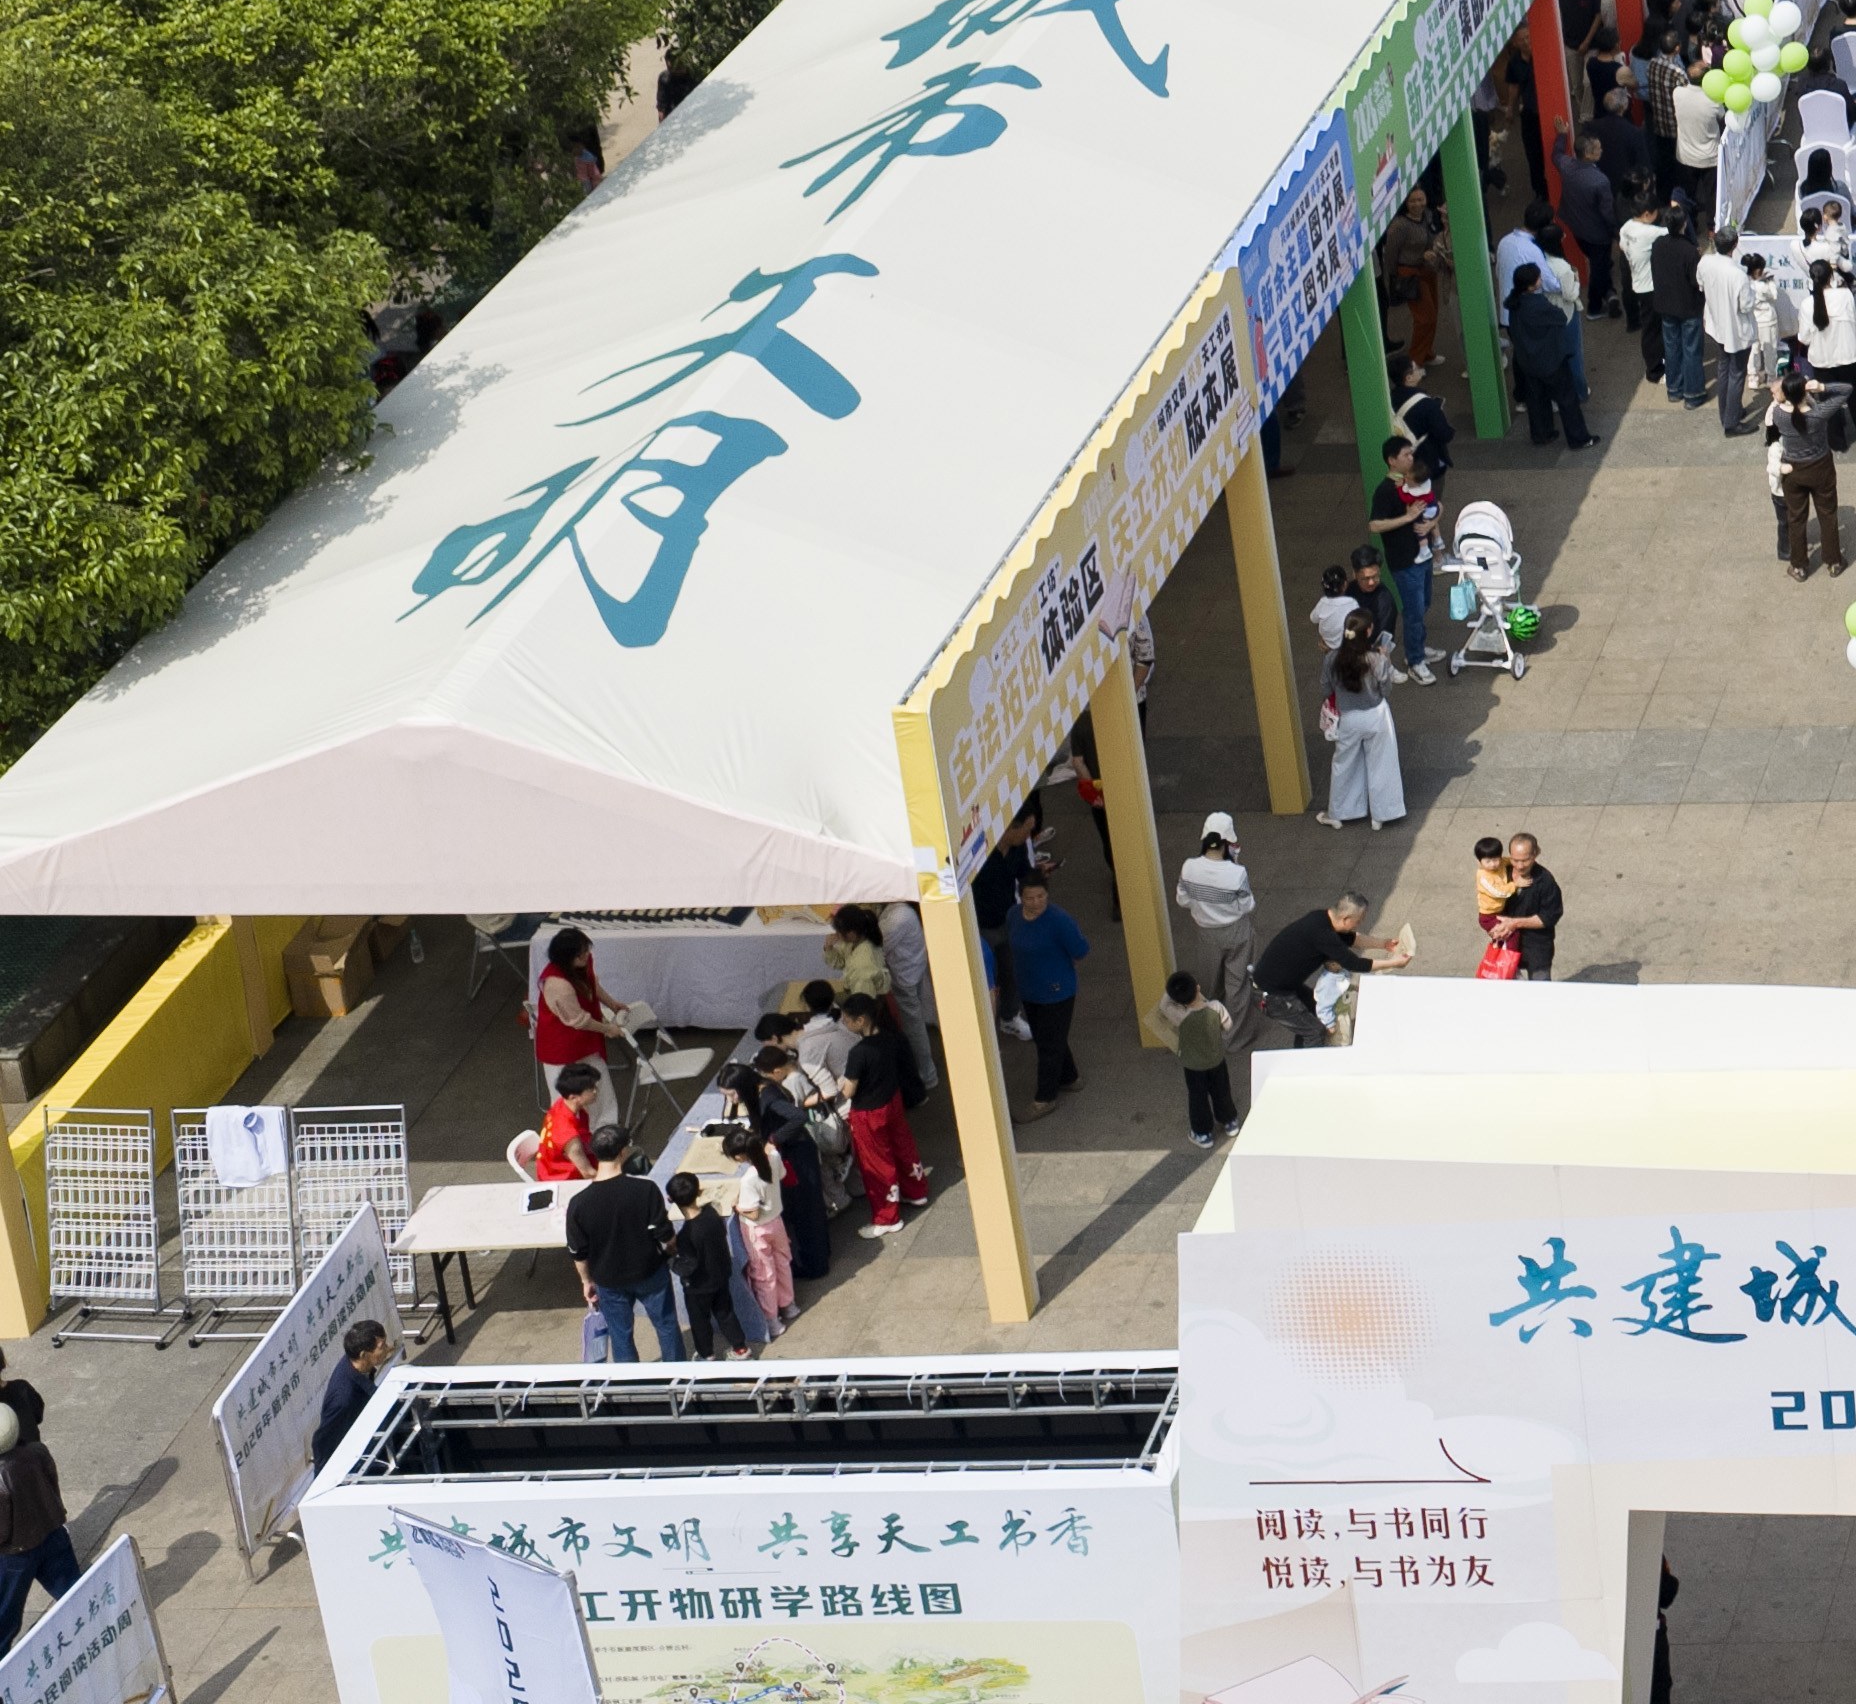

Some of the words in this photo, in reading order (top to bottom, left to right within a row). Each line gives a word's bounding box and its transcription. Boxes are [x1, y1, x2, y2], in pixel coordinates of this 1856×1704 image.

[1259, 170, 1347, 323] 新余主题图书展
[1110, 340, 1240, 567] 天工开物版本展
[951, 542, 1105, 804] 古法拓印体验区
[757, 1508, 1095, 1559] 共享天工书香
[25, 1582, 118, 1688] 共享天工书香
[33, 1600, 138, 1704] 民阅读活动周”
[579, 1582, 964, 1622] 工开物研学路线图
